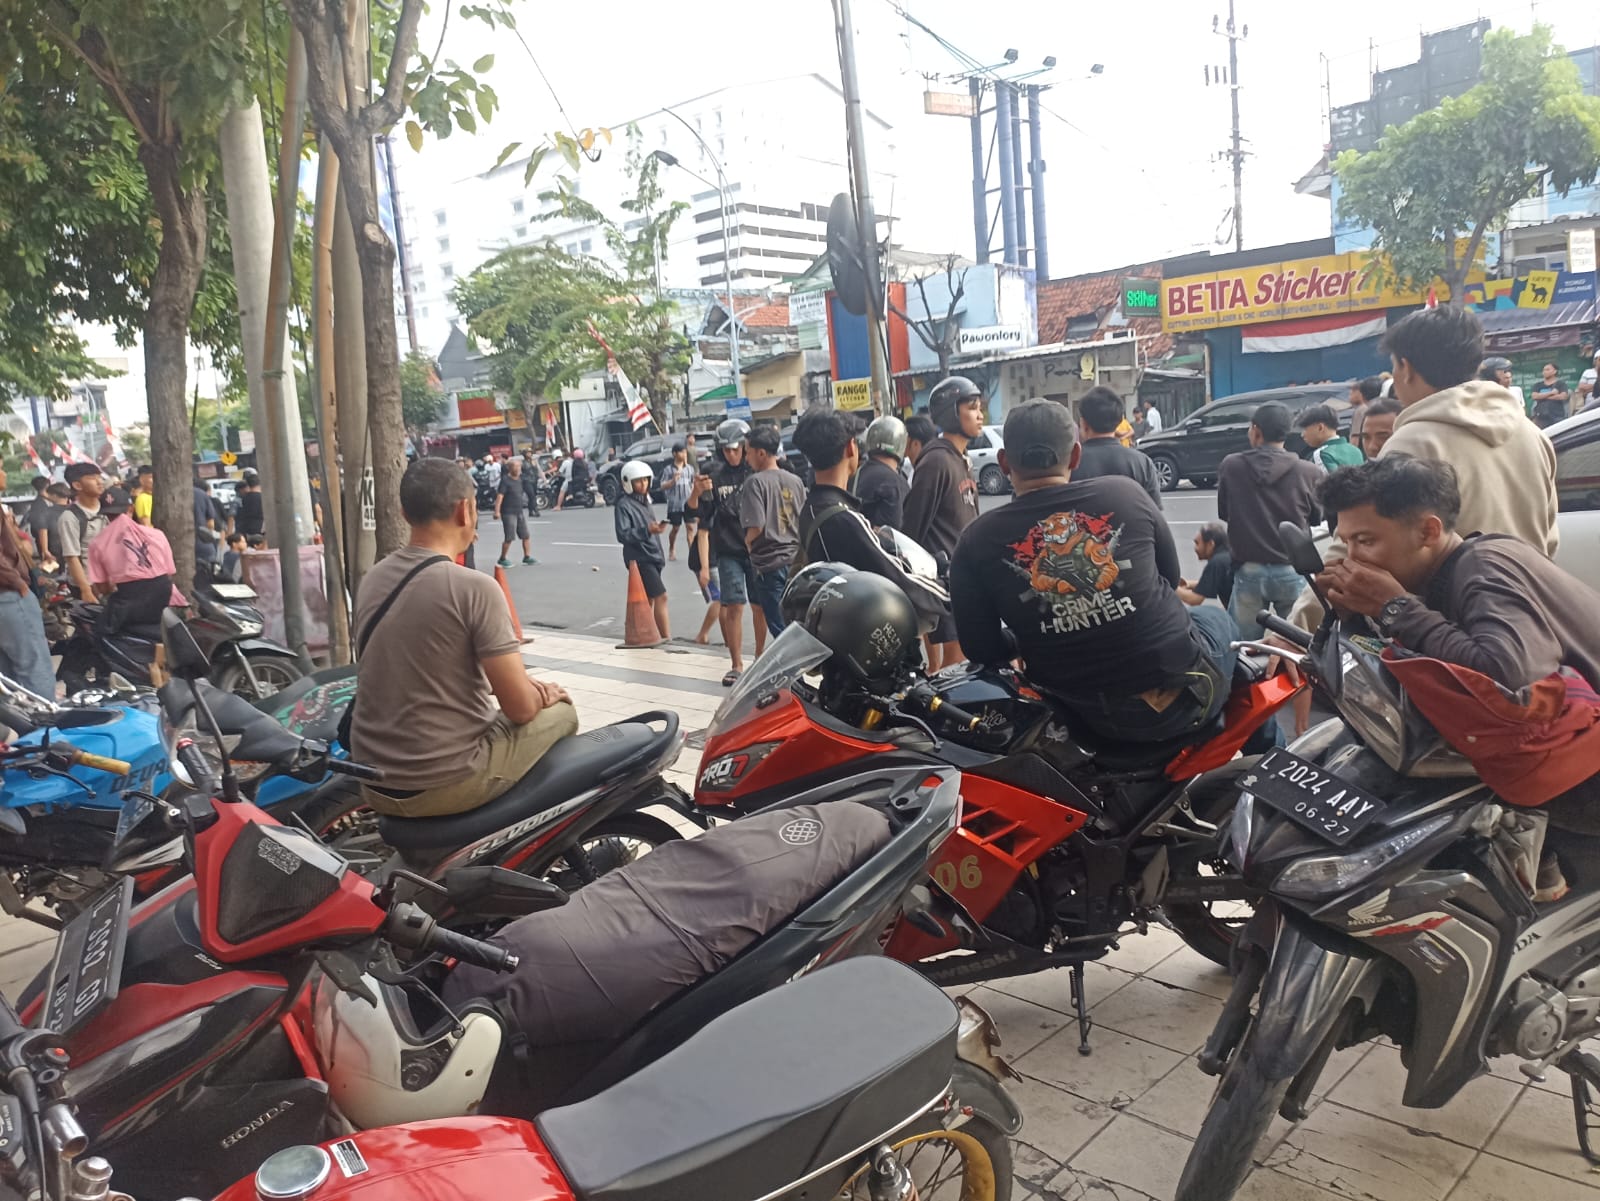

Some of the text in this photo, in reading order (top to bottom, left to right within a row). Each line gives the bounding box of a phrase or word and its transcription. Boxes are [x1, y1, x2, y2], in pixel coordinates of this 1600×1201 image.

[1168, 267, 1357, 317] BETTA Sticker
[1040, 596, 1137, 634] HUNTER
[1051, 588, 1114, 617] CRIME
[1260, 752, 1375, 819] L 2024 AAY
[92, 893, 117, 918] L
[220, 1100, 295, 1148] HONDA
